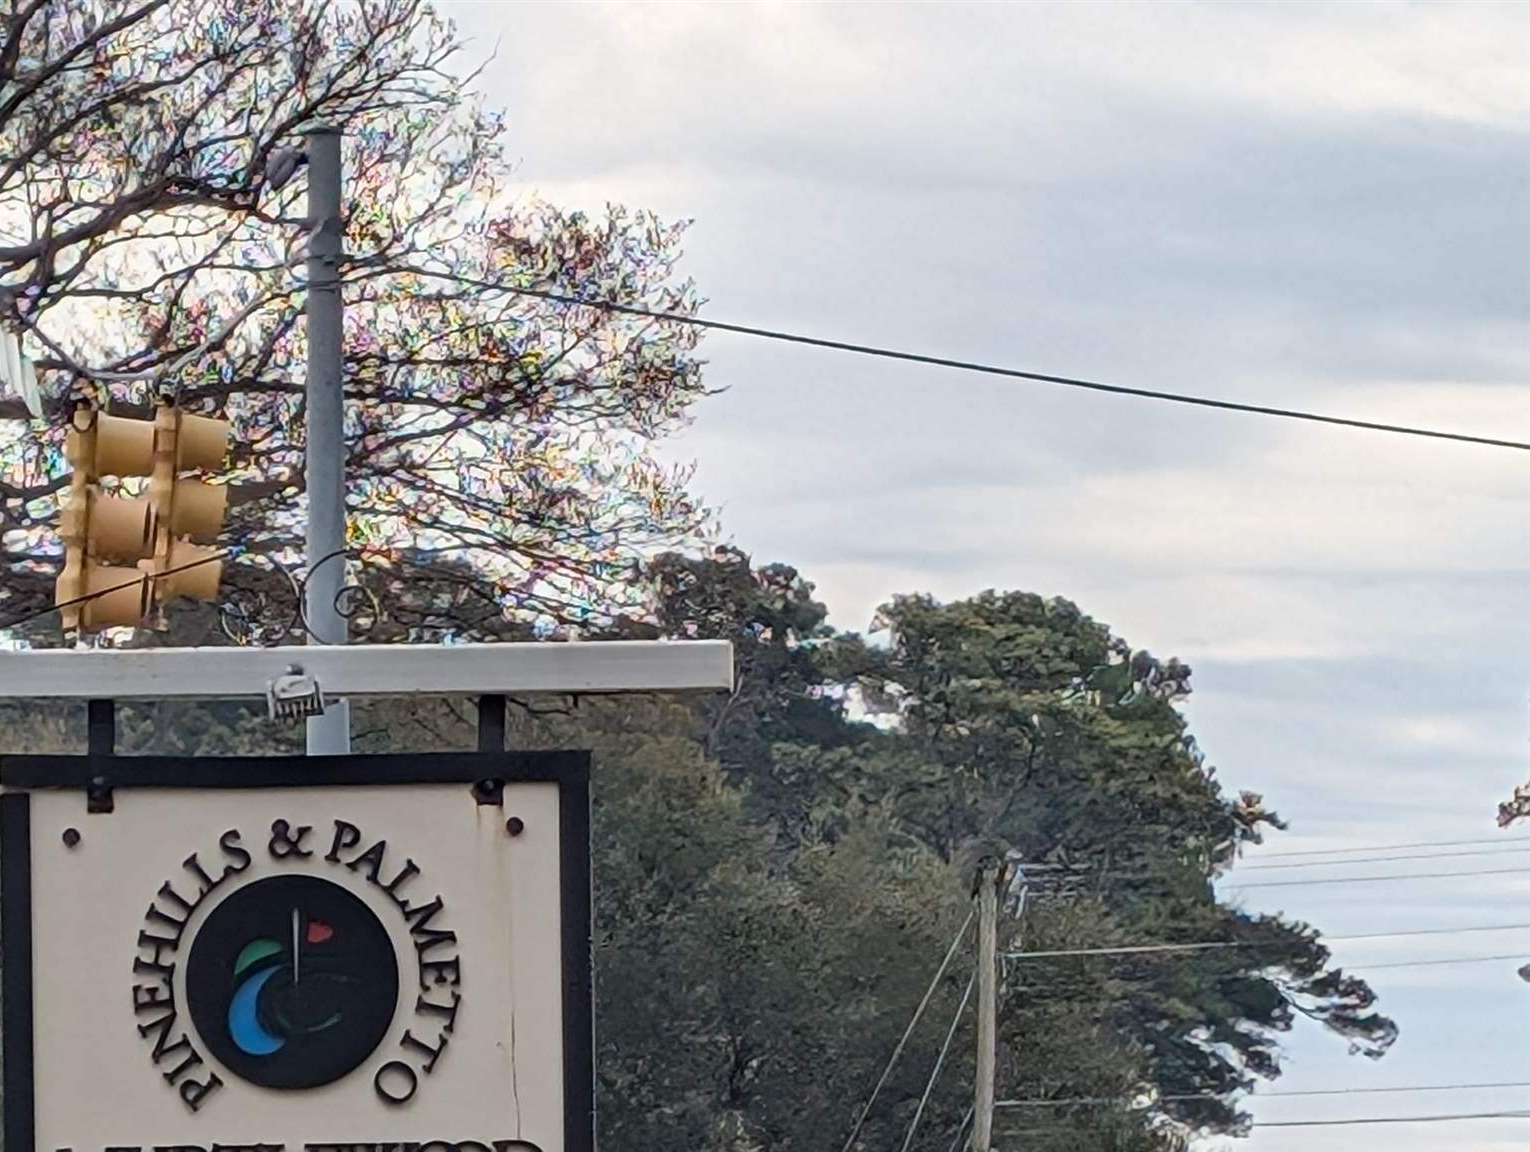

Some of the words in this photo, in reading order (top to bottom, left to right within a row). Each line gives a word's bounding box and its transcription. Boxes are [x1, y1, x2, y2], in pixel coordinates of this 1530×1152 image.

[132, 829, 252, 1112] PINEHILLS
[268, 818, 313, 859] &
[325, 819, 461, 1105] PALMETTO
